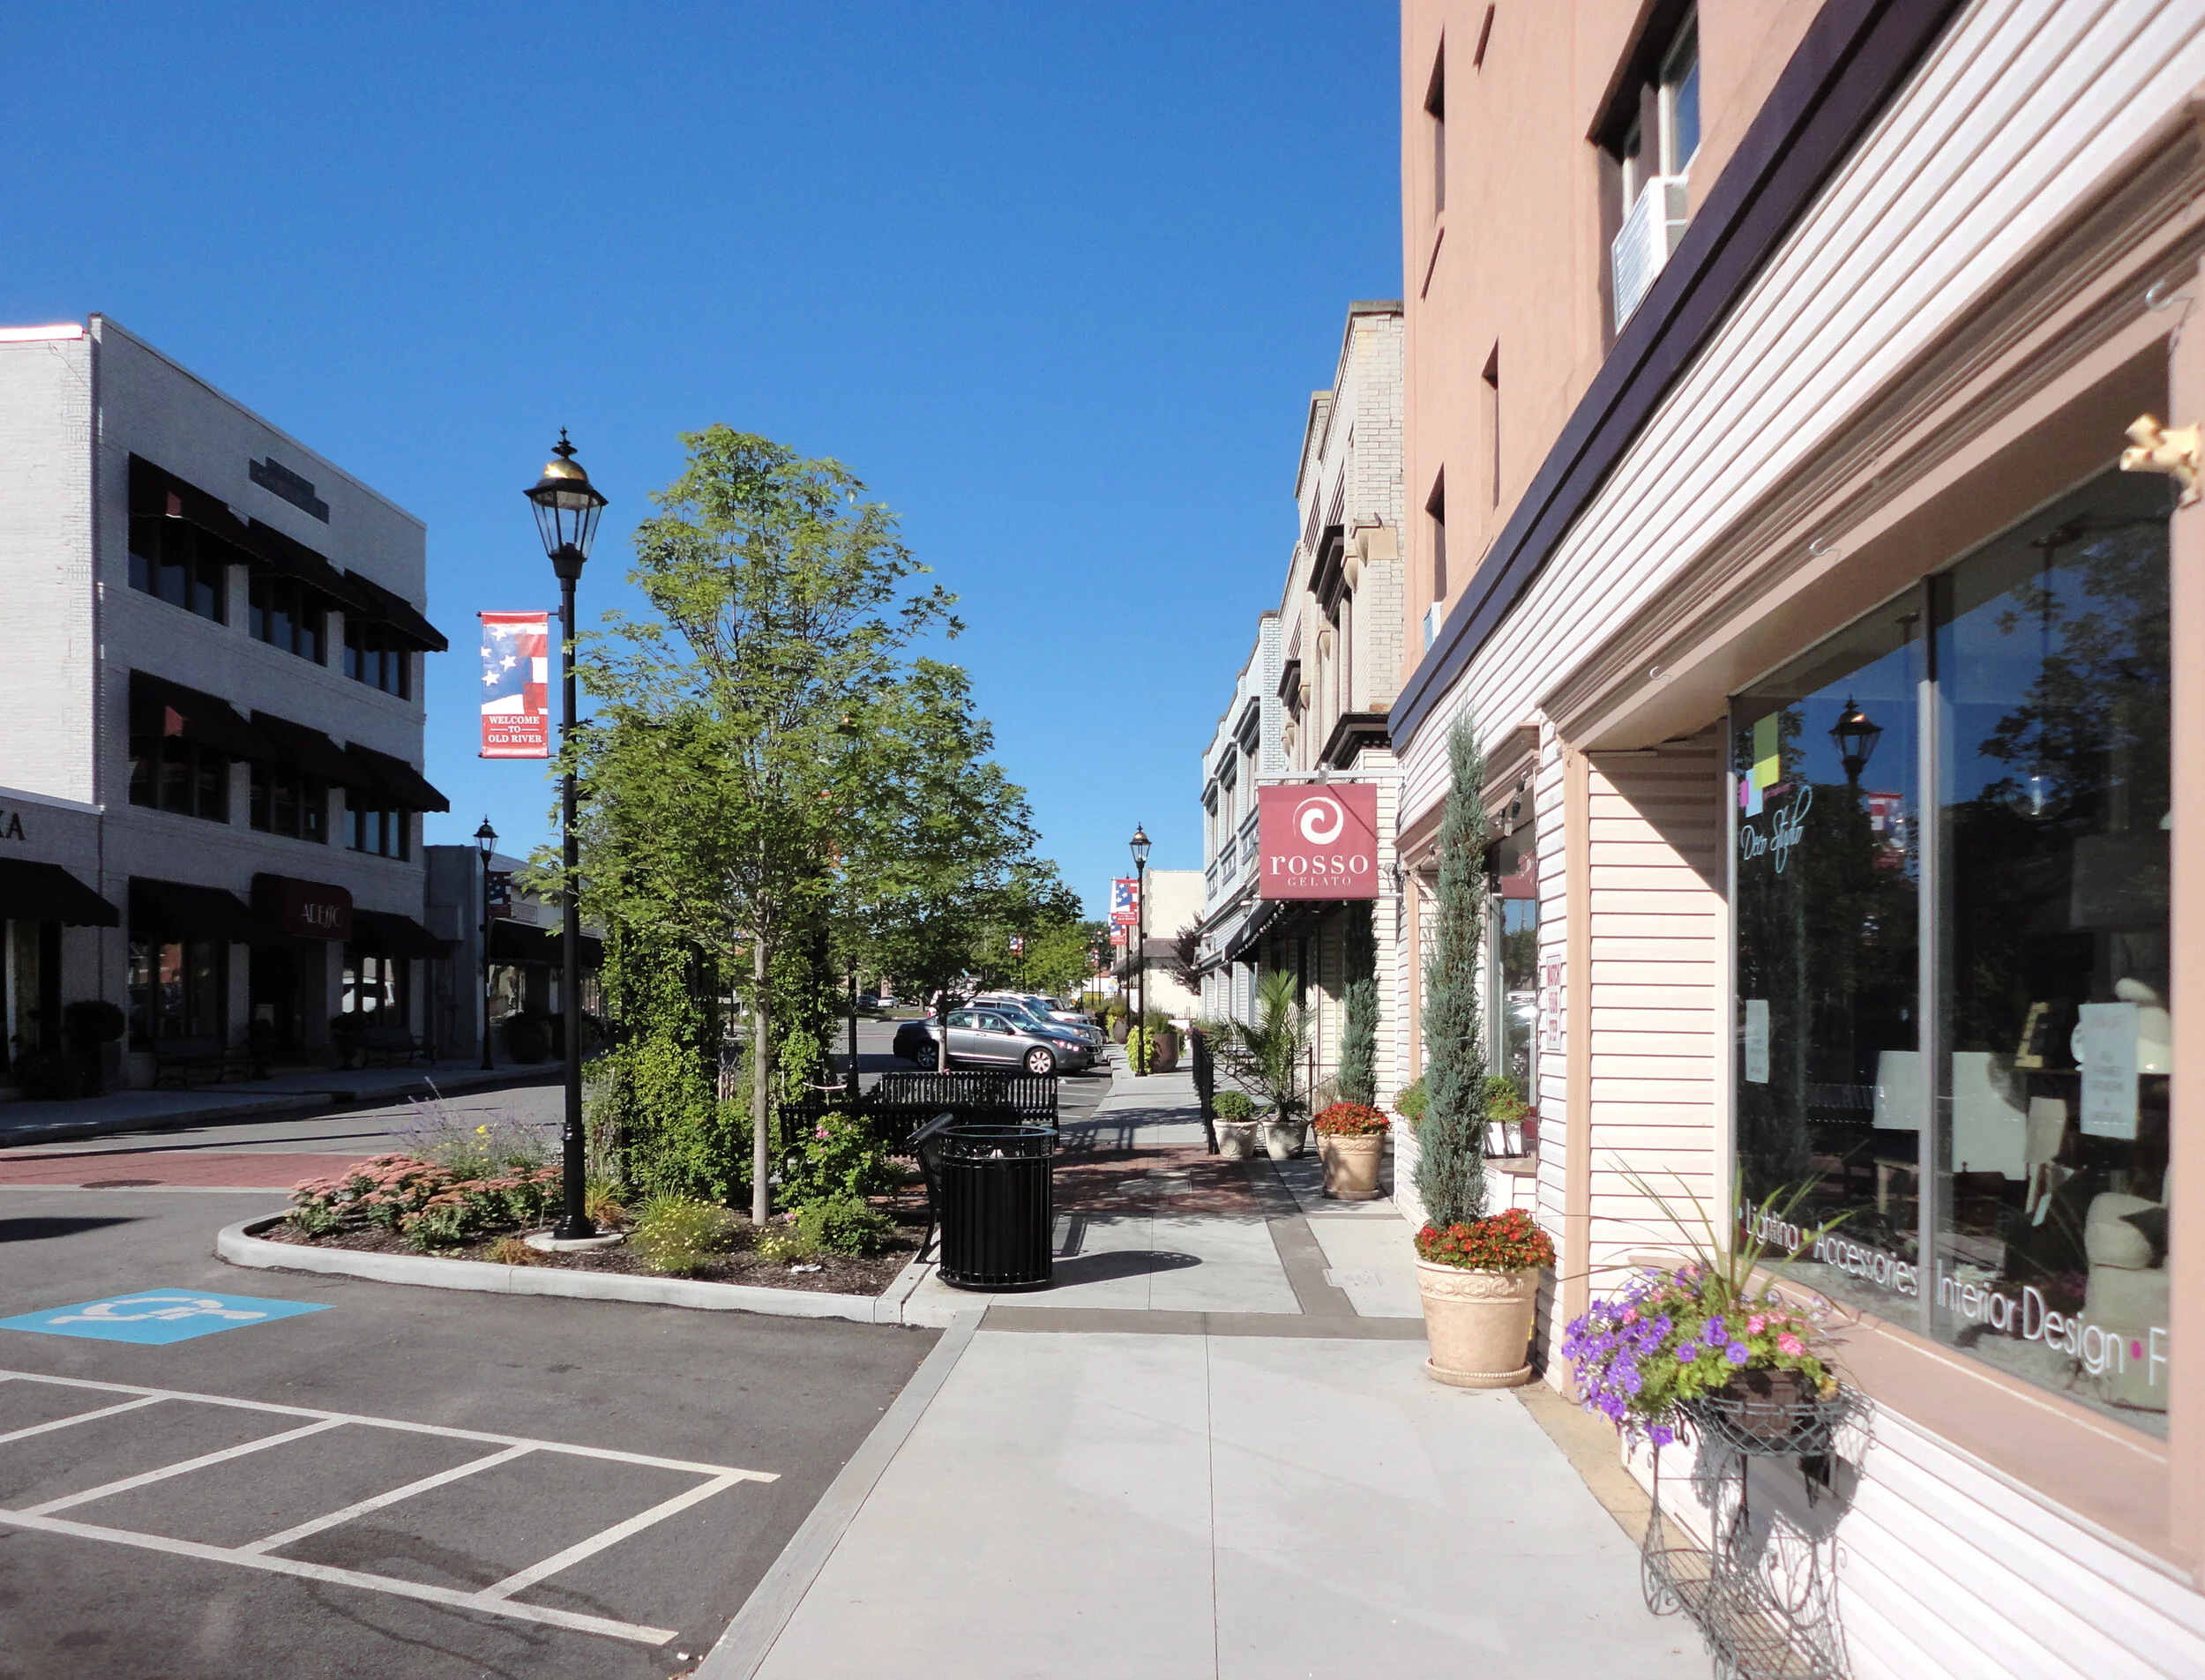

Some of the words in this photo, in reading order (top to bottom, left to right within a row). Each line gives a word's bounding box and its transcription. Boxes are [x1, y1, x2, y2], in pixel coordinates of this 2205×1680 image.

[1269, 855, 1369, 875] rosso
[1287, 877, 1351, 886] GELATO
[1745, 1198, 1799, 1256] Lighting
[1813, 1221, 1919, 1296] Accessories
[1936, 1258, 2016, 1333] Interior
[2022, 1284, 2124, 1375] Design
